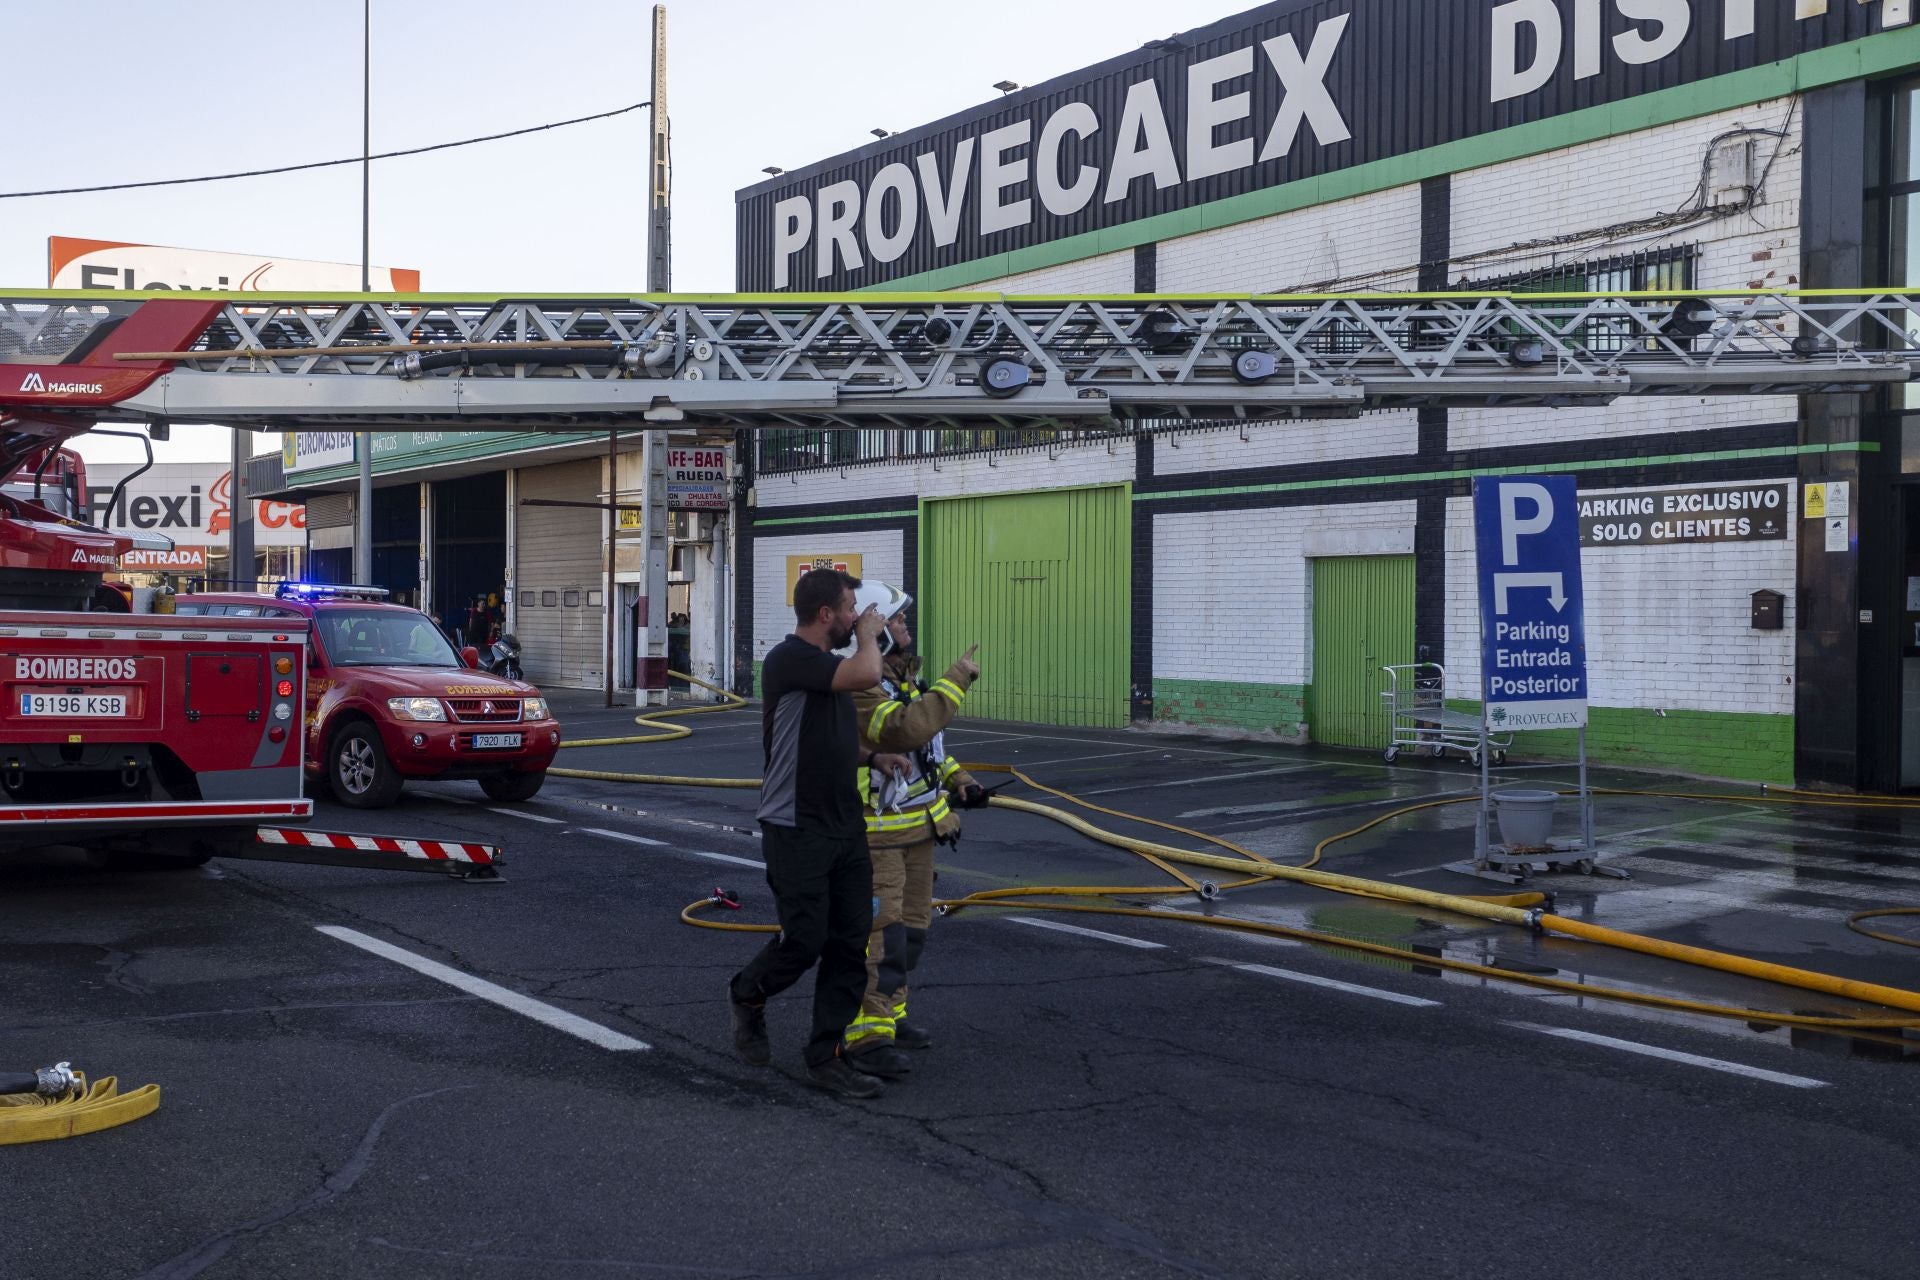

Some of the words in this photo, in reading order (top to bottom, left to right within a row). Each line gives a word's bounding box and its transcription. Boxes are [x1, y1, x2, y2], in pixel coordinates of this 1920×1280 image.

[774, 13, 1351, 290] PROVECAEX
[1491, 0, 1911, 102] DIS
[48, 382, 103, 394] MAGIRUS
[297, 432, 351, 456] EUROMASTER
[371, 434, 397, 454] UMÁTICOS
[667, 451, 724, 468] AFE-BAR
[677, 471, 724, 481] RUEDA
[86, 486, 200, 529] Flexi
[1664, 489, 1779, 513] EXCLUSIVO
[1498, 483, 1554, 566] P
[1592, 522, 1642, 541] SOLO
[1650, 517, 1751, 539] CLIENTES
[124, 551, 203, 565] ENTRADA
[812, 558, 833, 569] LECHE
[1495, 621, 1570, 644] Parking
[1496, 648, 1572, 668] Entrada
[15, 657, 137, 680] BOMBEROS
[1490, 674, 1580, 695] Posterior
[34, 697, 81, 713] 9196
[87, 698, 121, 714] KSB
[1508, 712, 1578, 725] PROVECAEX
[479, 735, 499, 746] 7920
[504, 735, 518, 746] FLK
